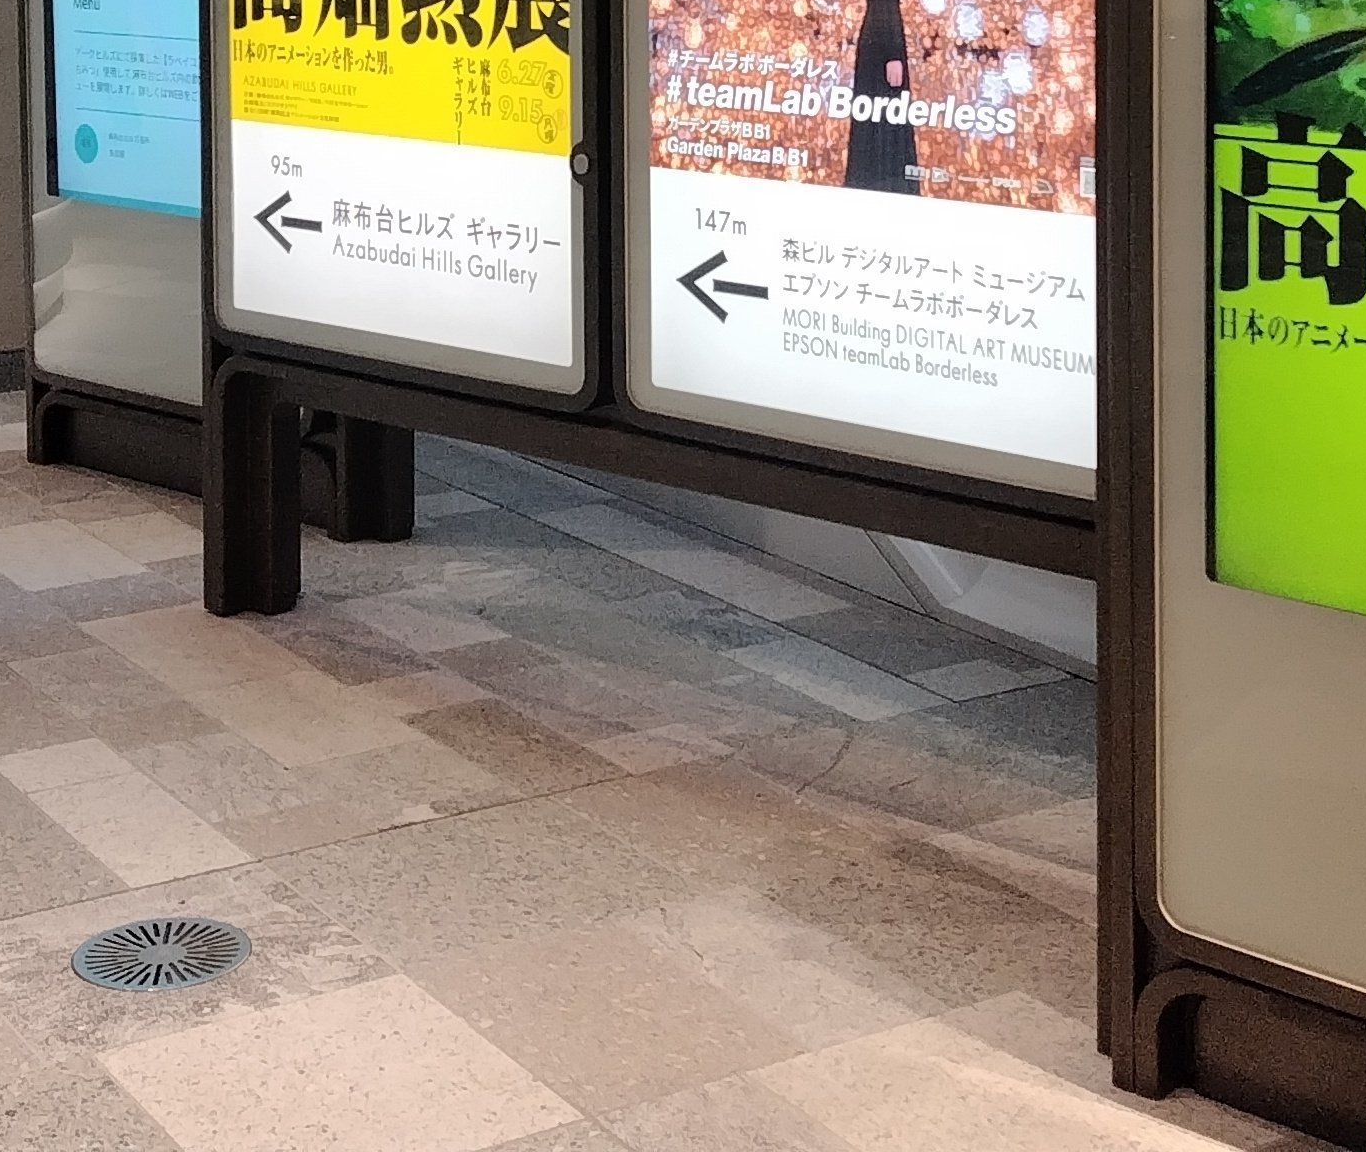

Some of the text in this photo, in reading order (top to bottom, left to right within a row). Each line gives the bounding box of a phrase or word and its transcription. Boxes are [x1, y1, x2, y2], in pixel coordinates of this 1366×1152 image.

[233, 38, 394, 76] 日本のアニメーションを作った男。
[497, 58, 547, 87] 6.27
[243, 75, 358, 97] AZABUDAI HILLS GALLERY
[452, 57, 464, 145] ギャラリー
[466, 58, 478, 115] ヒルズ
[498, 95, 544, 125] 9.15
[827, 85, 1017, 135] Borderless
[270, 154, 303, 178] 95m
[667, 136, 724, 159] Garden
[332, 198, 562, 254] 麻布台ヒルズ ギャラリー
[332, 234, 538, 294] Azabudai Hills Gallery
[782, 238, 1085, 301] 森ビル デジタルアート ミュージアム
[782, 273, 1038, 330] エプソン チームラボボーダレス
[782, 307, 1096, 376] MORI Building DIGITAL ART MUSEUM
[783, 331, 998, 387] EPSON teamLab Borderless
